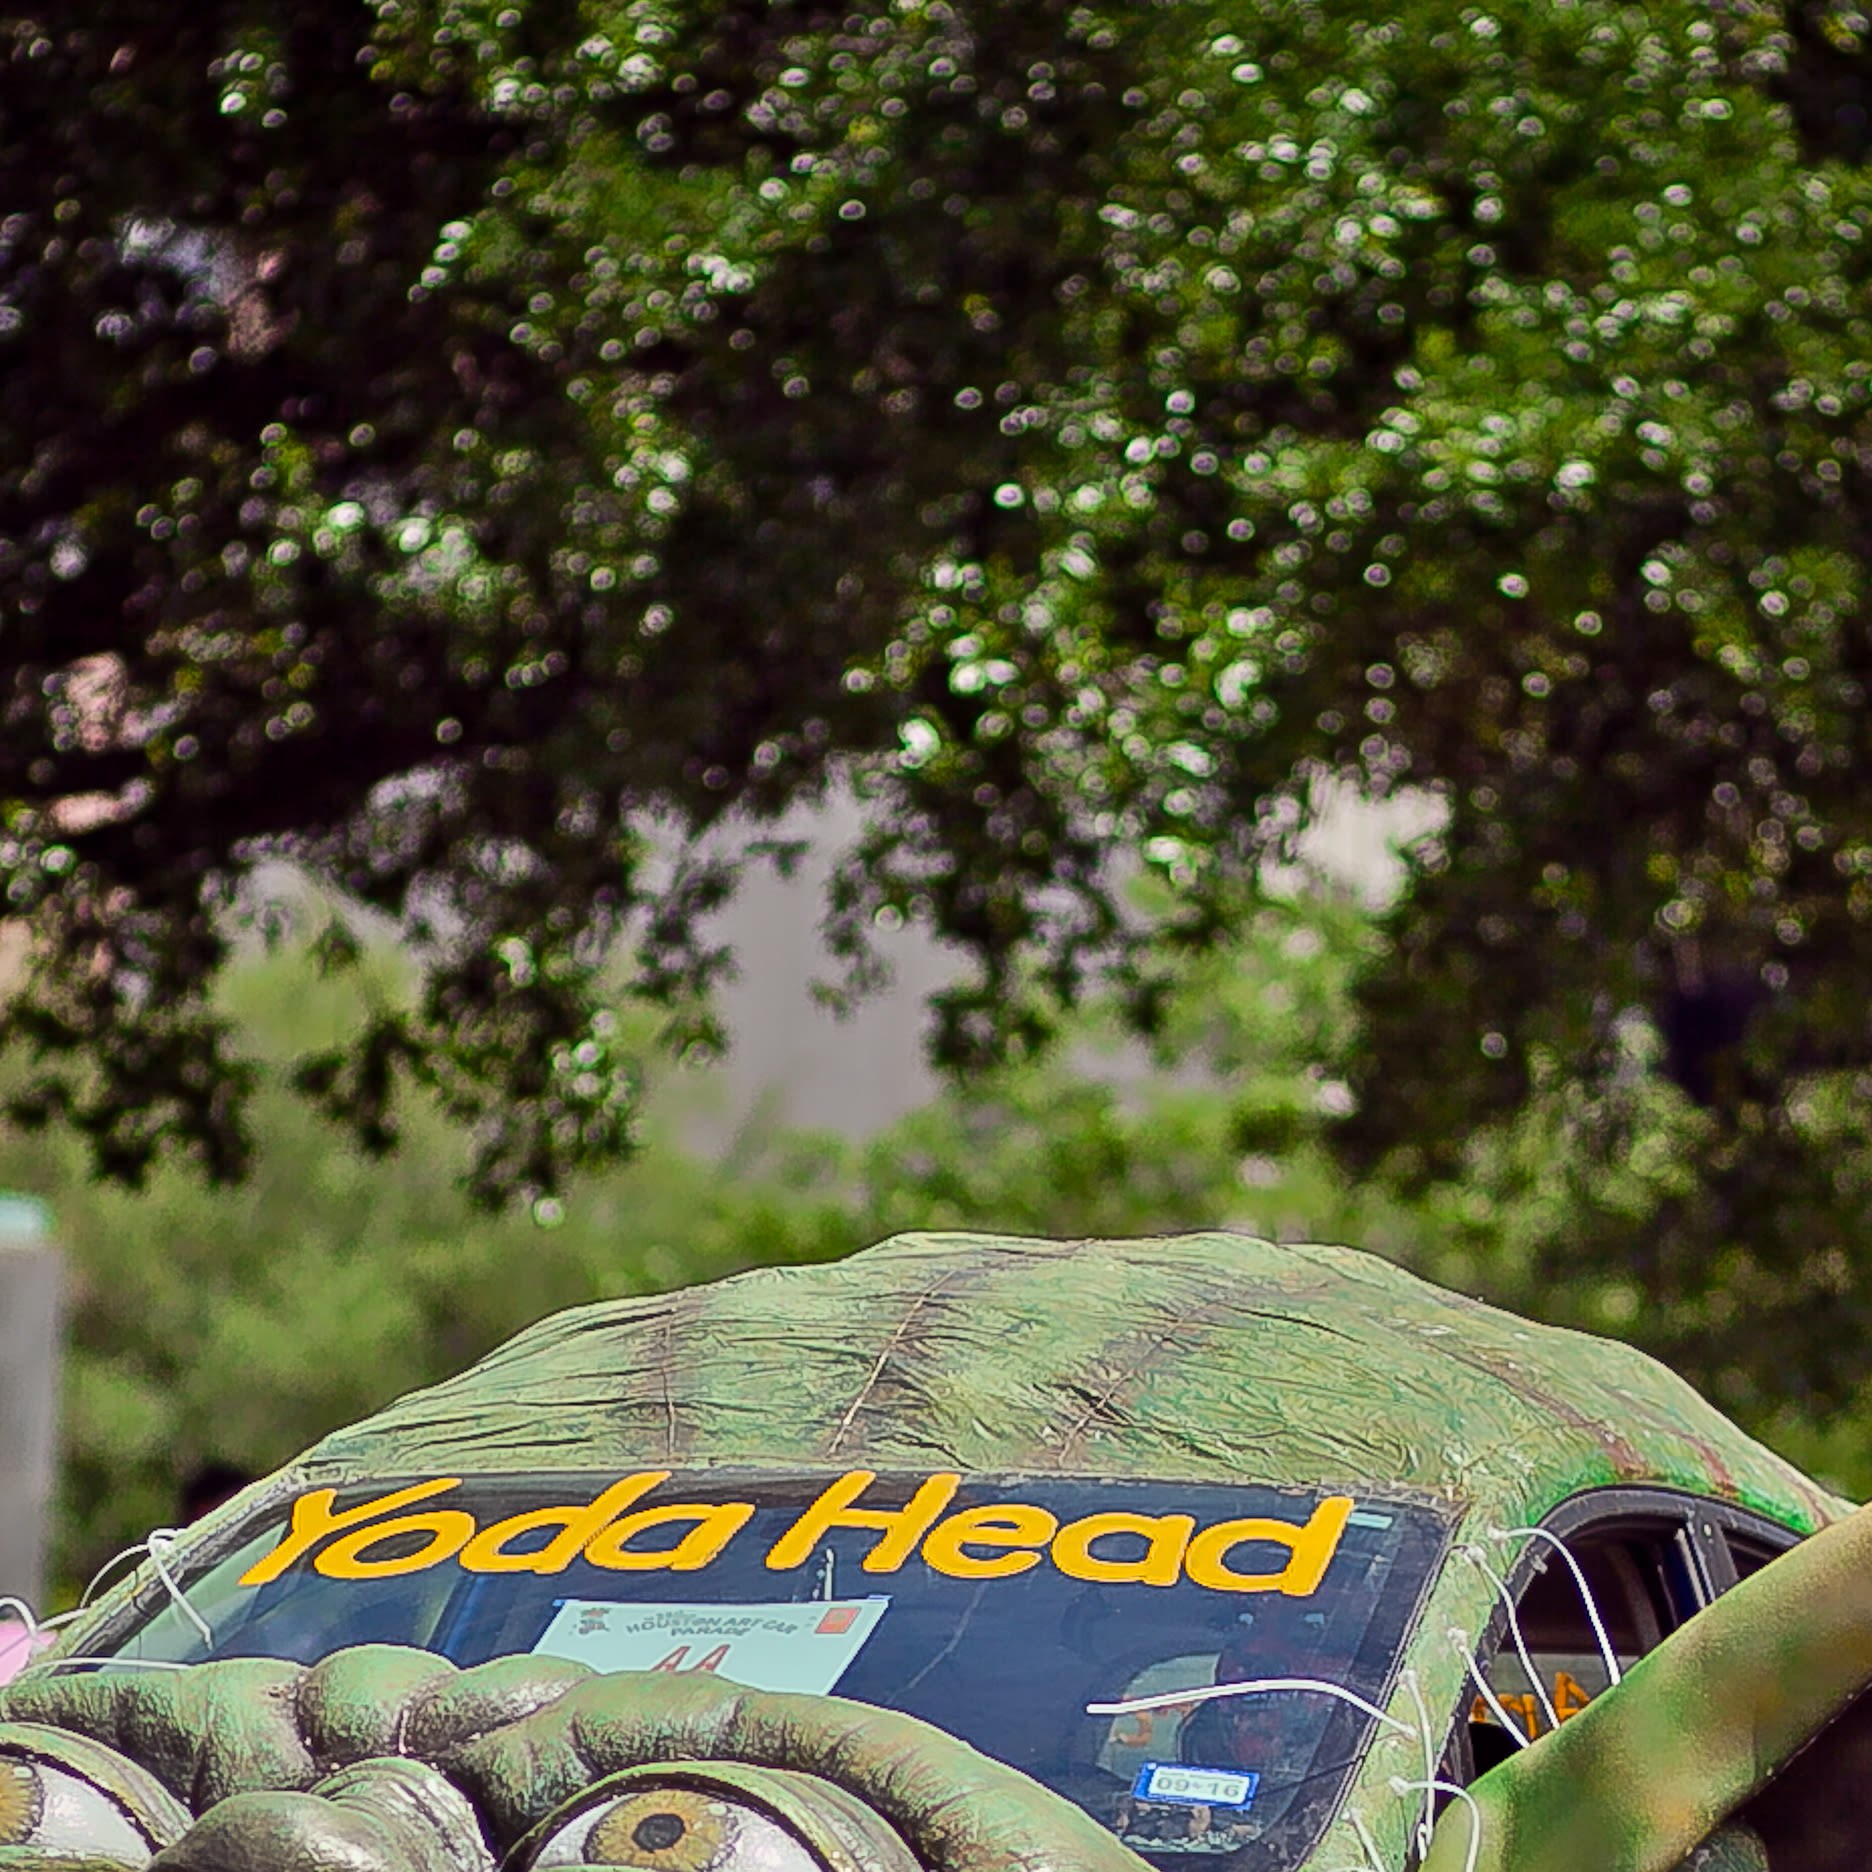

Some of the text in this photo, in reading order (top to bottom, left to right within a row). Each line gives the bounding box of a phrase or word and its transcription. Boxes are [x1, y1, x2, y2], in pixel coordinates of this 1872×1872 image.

[238, 1469, 1355, 1597] Yoda Head
[625, 1614, 720, 1635] HOUSTON
[721, 1615, 764, 1628] ART
